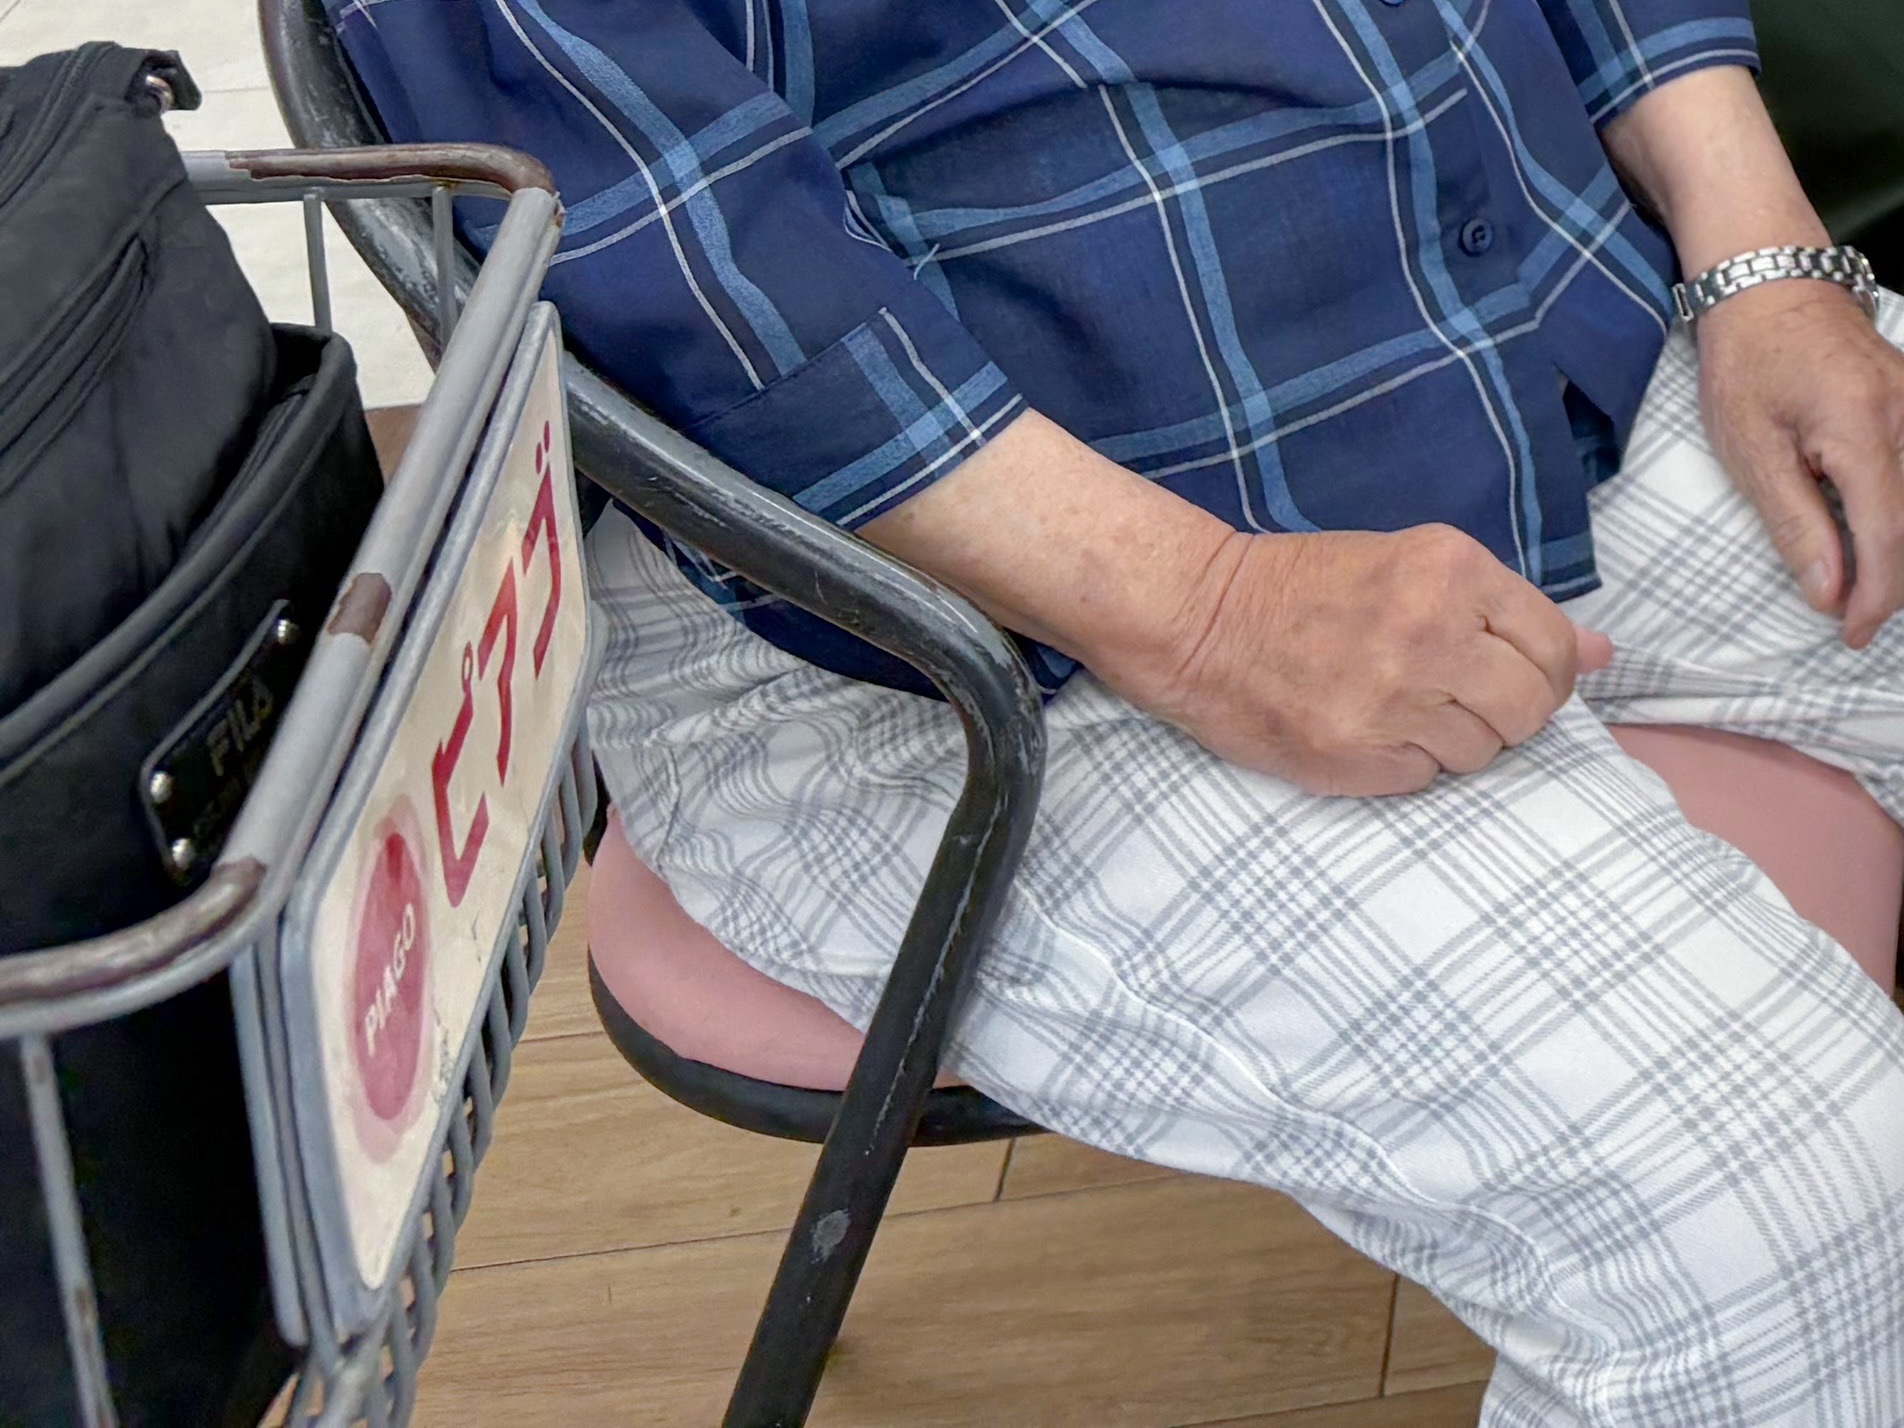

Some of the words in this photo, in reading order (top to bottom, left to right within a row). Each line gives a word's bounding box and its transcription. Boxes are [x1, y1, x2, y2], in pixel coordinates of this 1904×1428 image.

[430, 419, 562, 909] ピアゴ
[365, 902, 416, 1056] PIAGO
